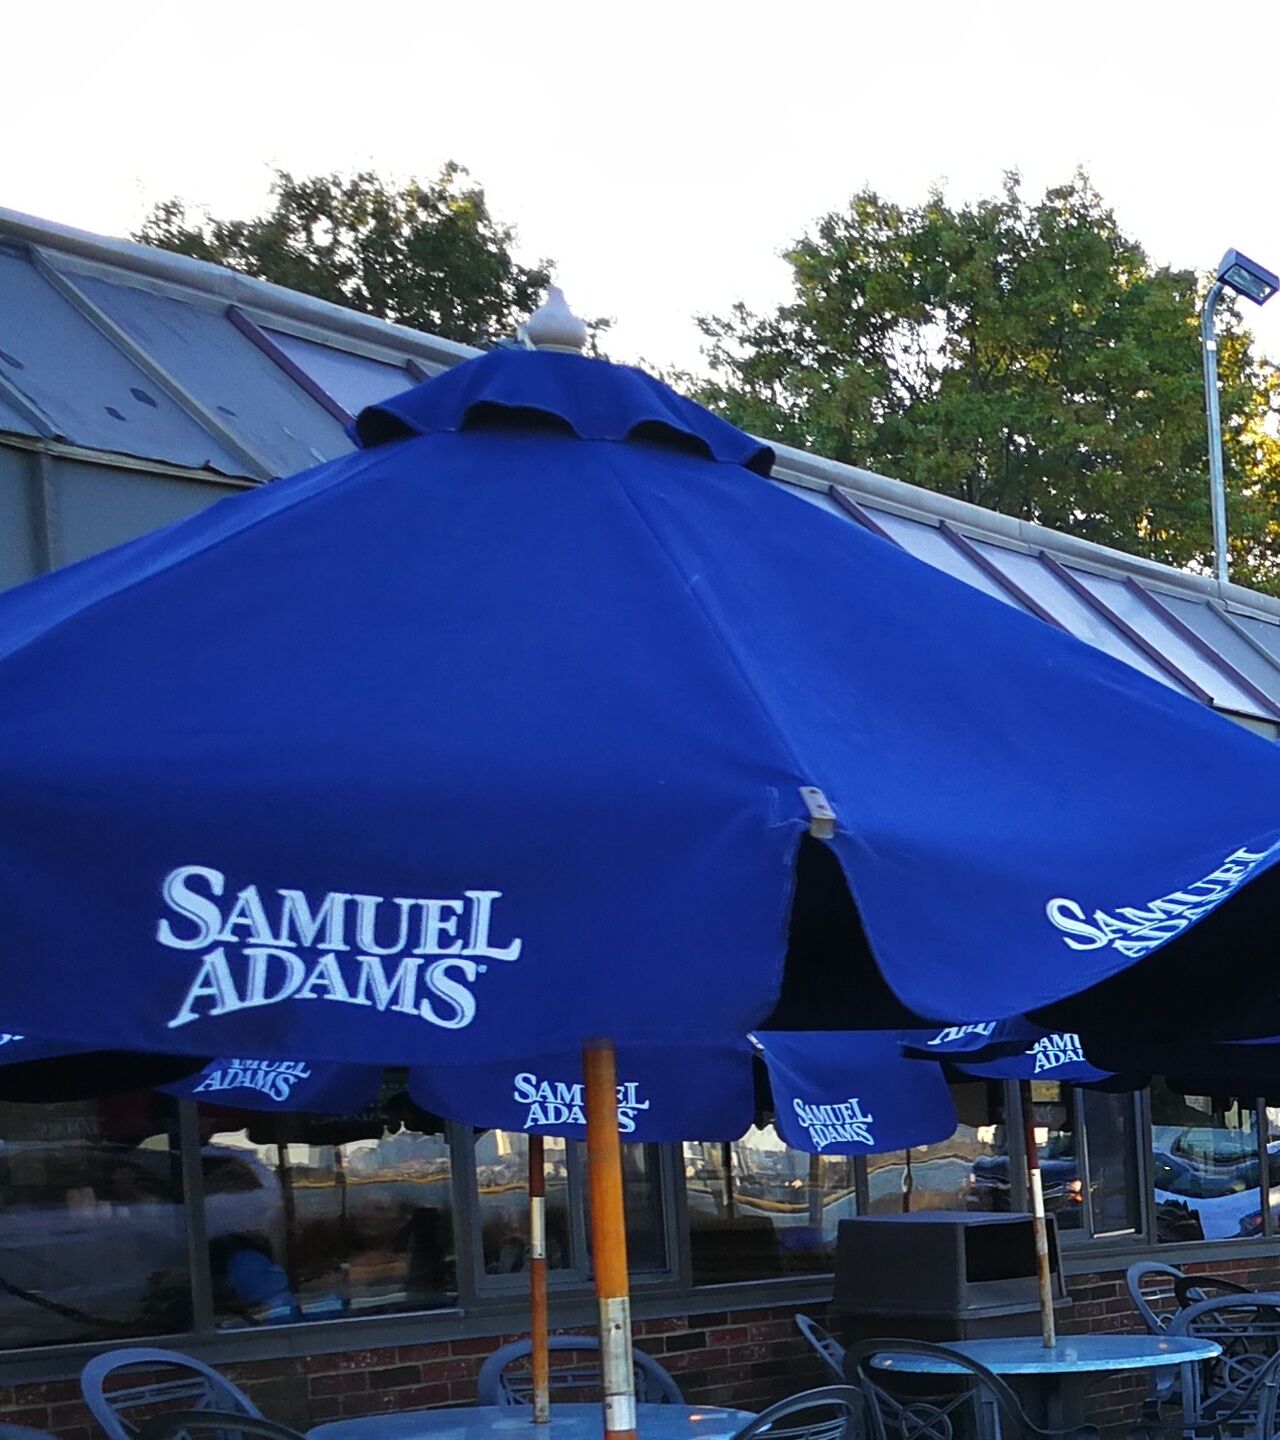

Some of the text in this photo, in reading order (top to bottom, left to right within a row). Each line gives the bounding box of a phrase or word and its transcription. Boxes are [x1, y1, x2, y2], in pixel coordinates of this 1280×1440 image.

[156, 864, 522, 961] SAMUEL
[167, 946, 478, 1029] ADAMS
[1033, 1049, 1086, 1074] ADA
[192, 1068, 298, 1102] ADAMS
[513, 1072, 650, 1110] SAMEL
[523, 1102, 636, 1133] ADAS
[793, 1098, 874, 1128] SAMUEL
[808, 1123, 875, 1152] ADAMS
